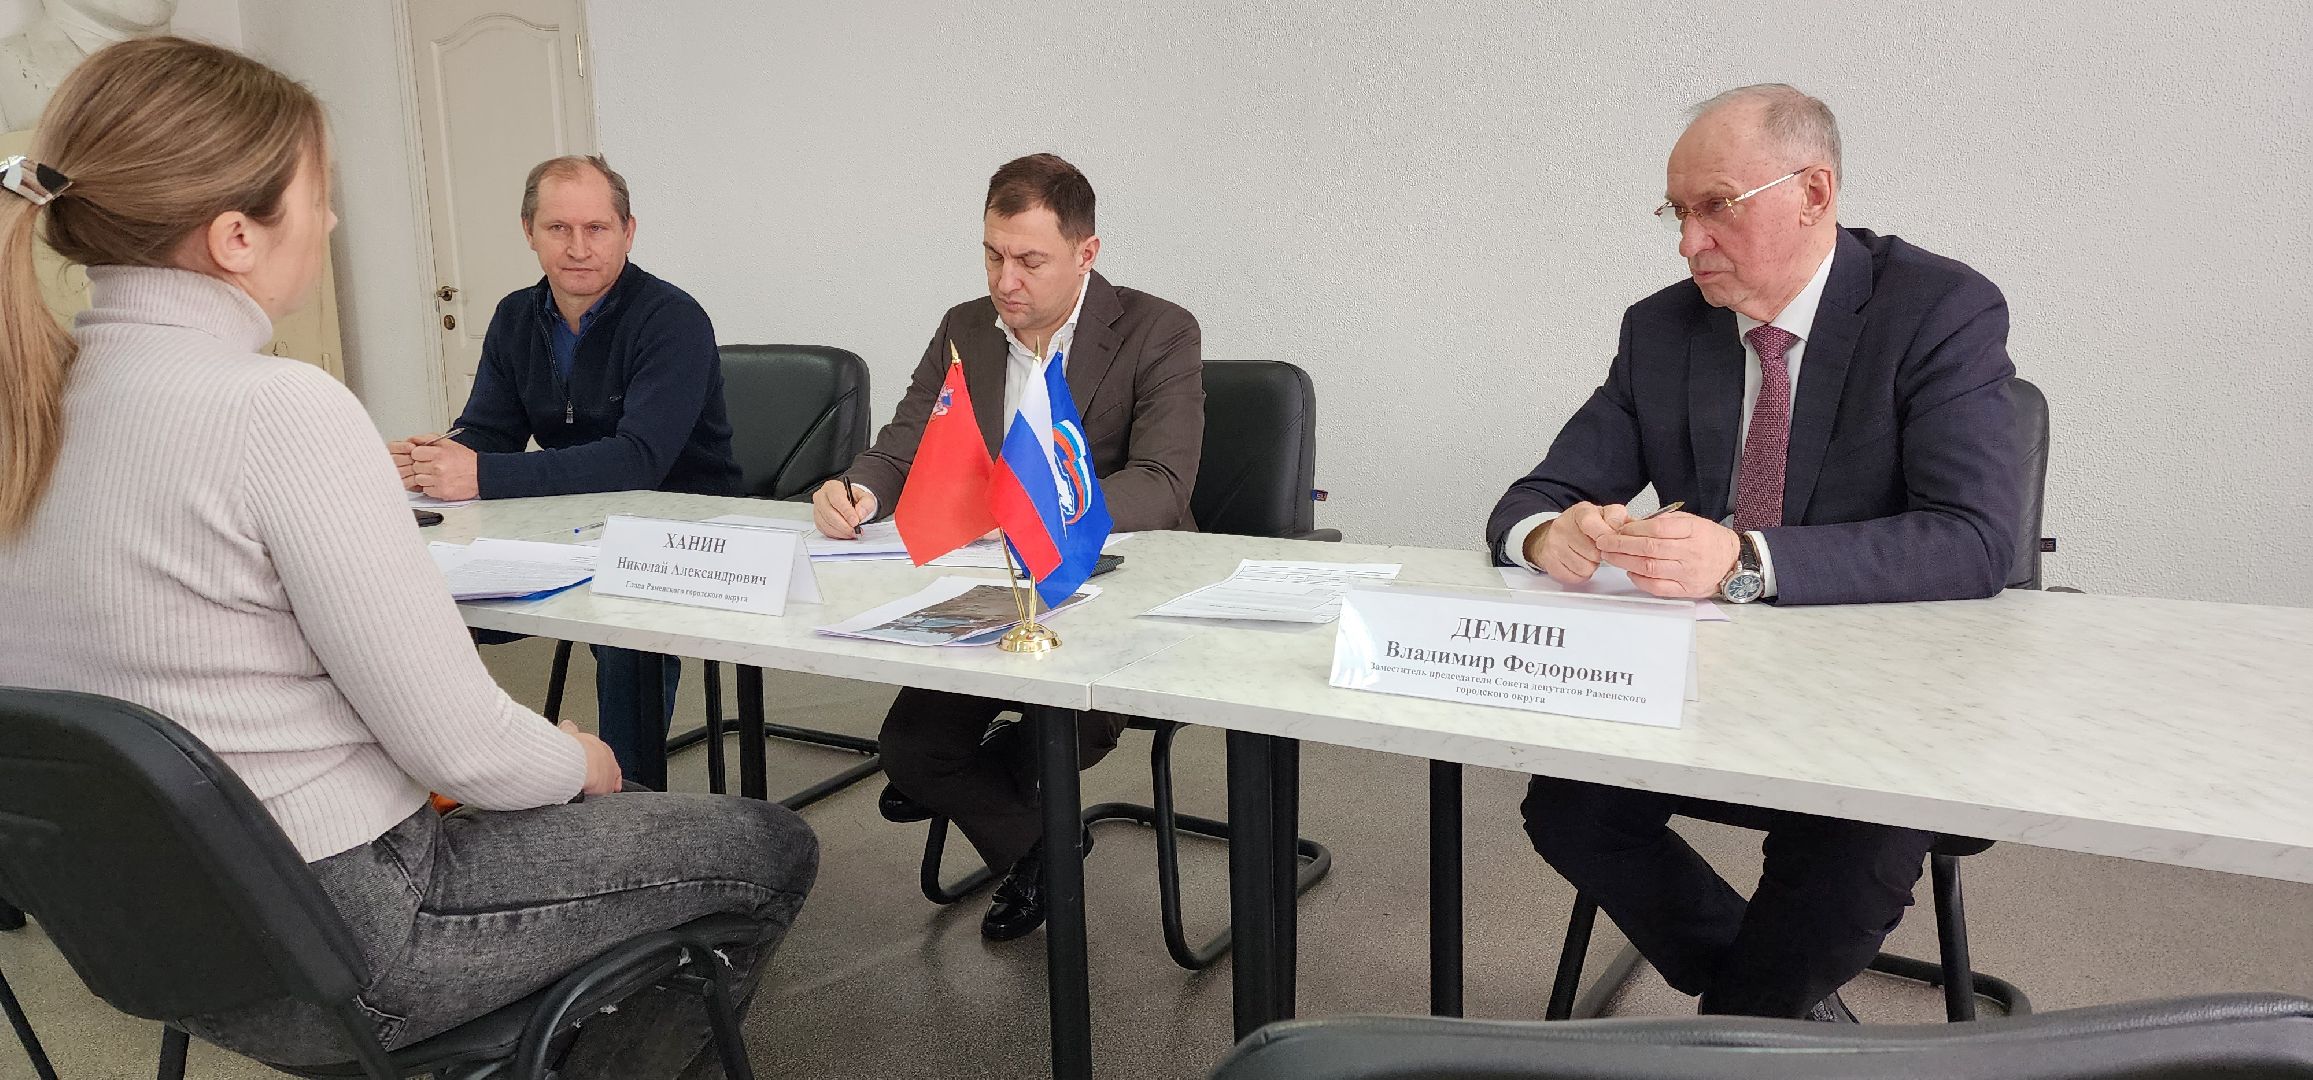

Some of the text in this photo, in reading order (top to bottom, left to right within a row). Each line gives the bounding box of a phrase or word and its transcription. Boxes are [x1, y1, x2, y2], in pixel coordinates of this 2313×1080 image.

[664, 533, 728, 554] ХАНИН
[617, 557, 767, 586] Николай Александрович
[1450, 617, 1567, 649] ДЕМИН
[1385, 640, 1635, 687] Владимир Федорович
[1370, 662, 1428, 675] Заместитель
[1494, 676, 1529, 689] Совета
[1531, 682, 1583, 696] депутатов
[1585, 688, 1647, 703] Раменского
[1455, 685, 1546, 704] городского округа
